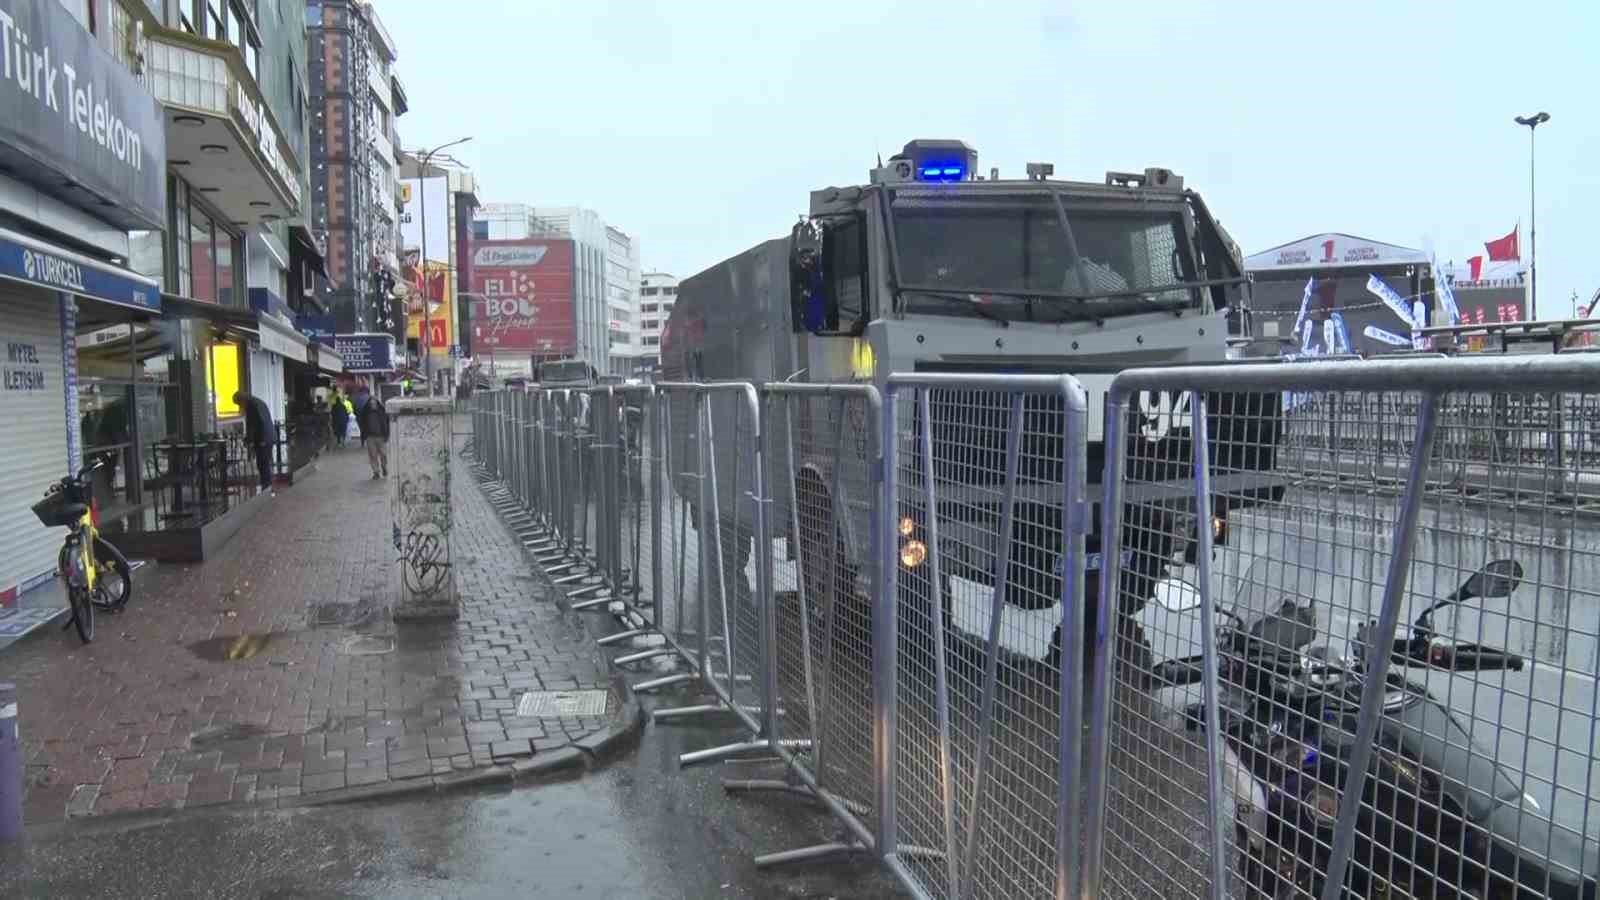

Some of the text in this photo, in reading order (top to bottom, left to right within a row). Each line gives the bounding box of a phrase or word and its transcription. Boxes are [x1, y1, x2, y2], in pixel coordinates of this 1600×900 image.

[0, 12, 58, 112] Türk
[63, 62, 142, 171] Telekom
[33, 252, 86, 291] TURKCELL
